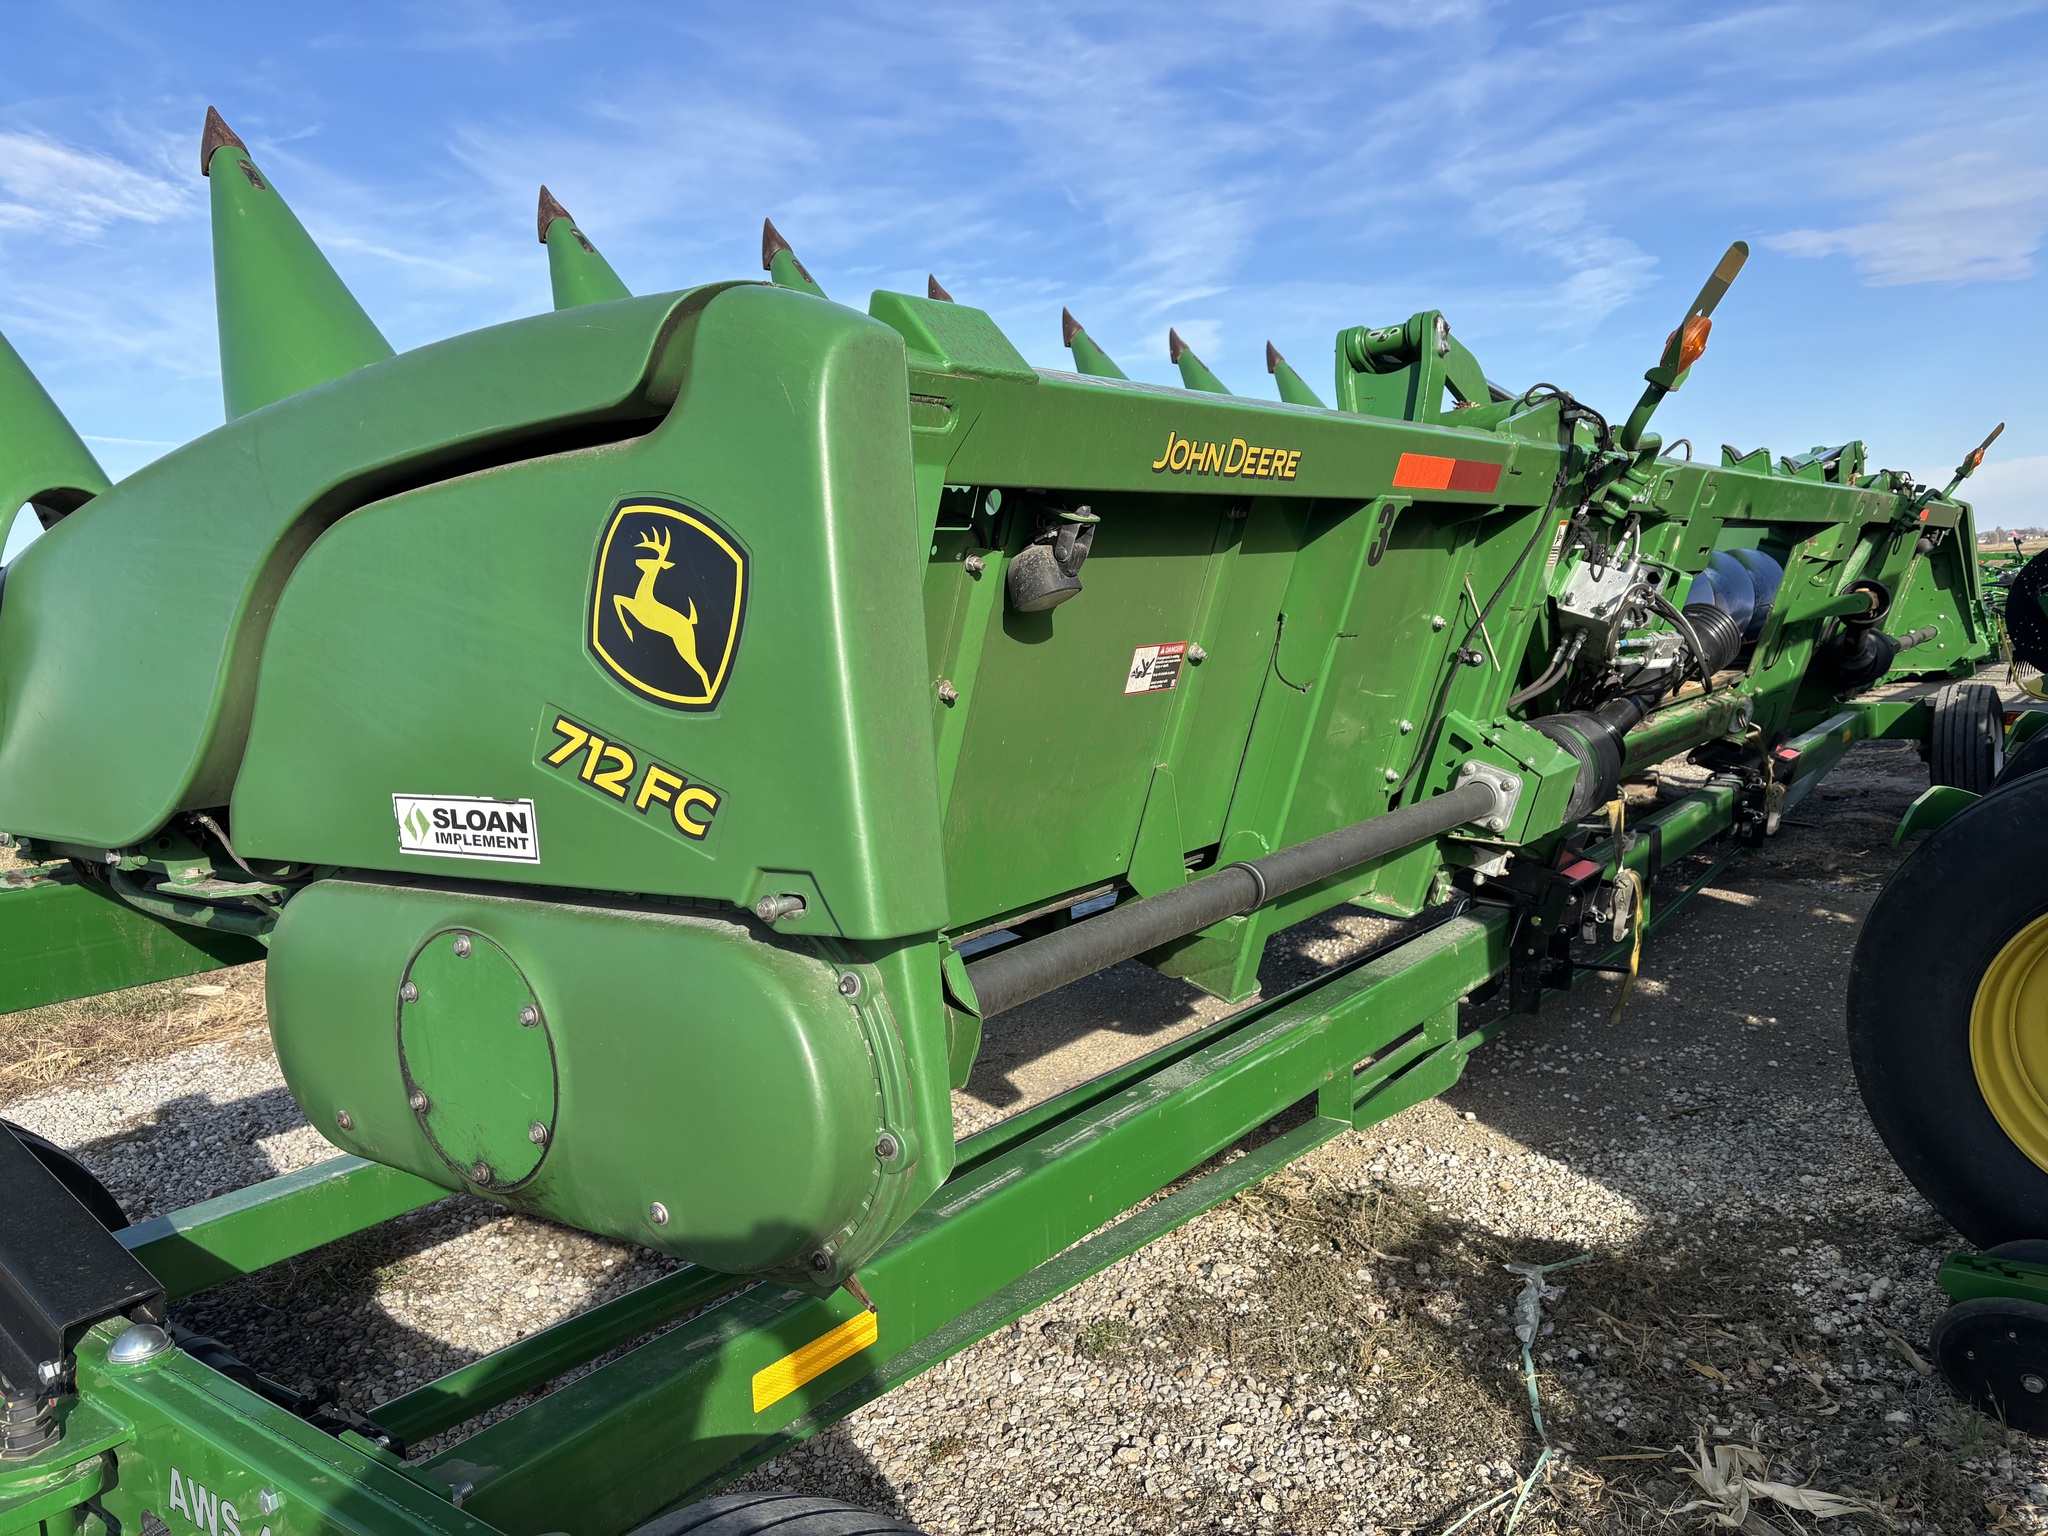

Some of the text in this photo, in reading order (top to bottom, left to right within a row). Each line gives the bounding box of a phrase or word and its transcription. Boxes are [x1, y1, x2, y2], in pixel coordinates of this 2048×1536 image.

[1152, 431, 1302, 481] JOHN DEERE
[1367, 503, 1395, 567] 3
[1164, 645, 1184, 653] DANGER
[542, 714, 723, 841] 712 FC
[432, 807, 528, 834] SLOAN
[435, 831, 529, 850] IMPLEMENT
[168, 1465, 242, 1536] AWS
